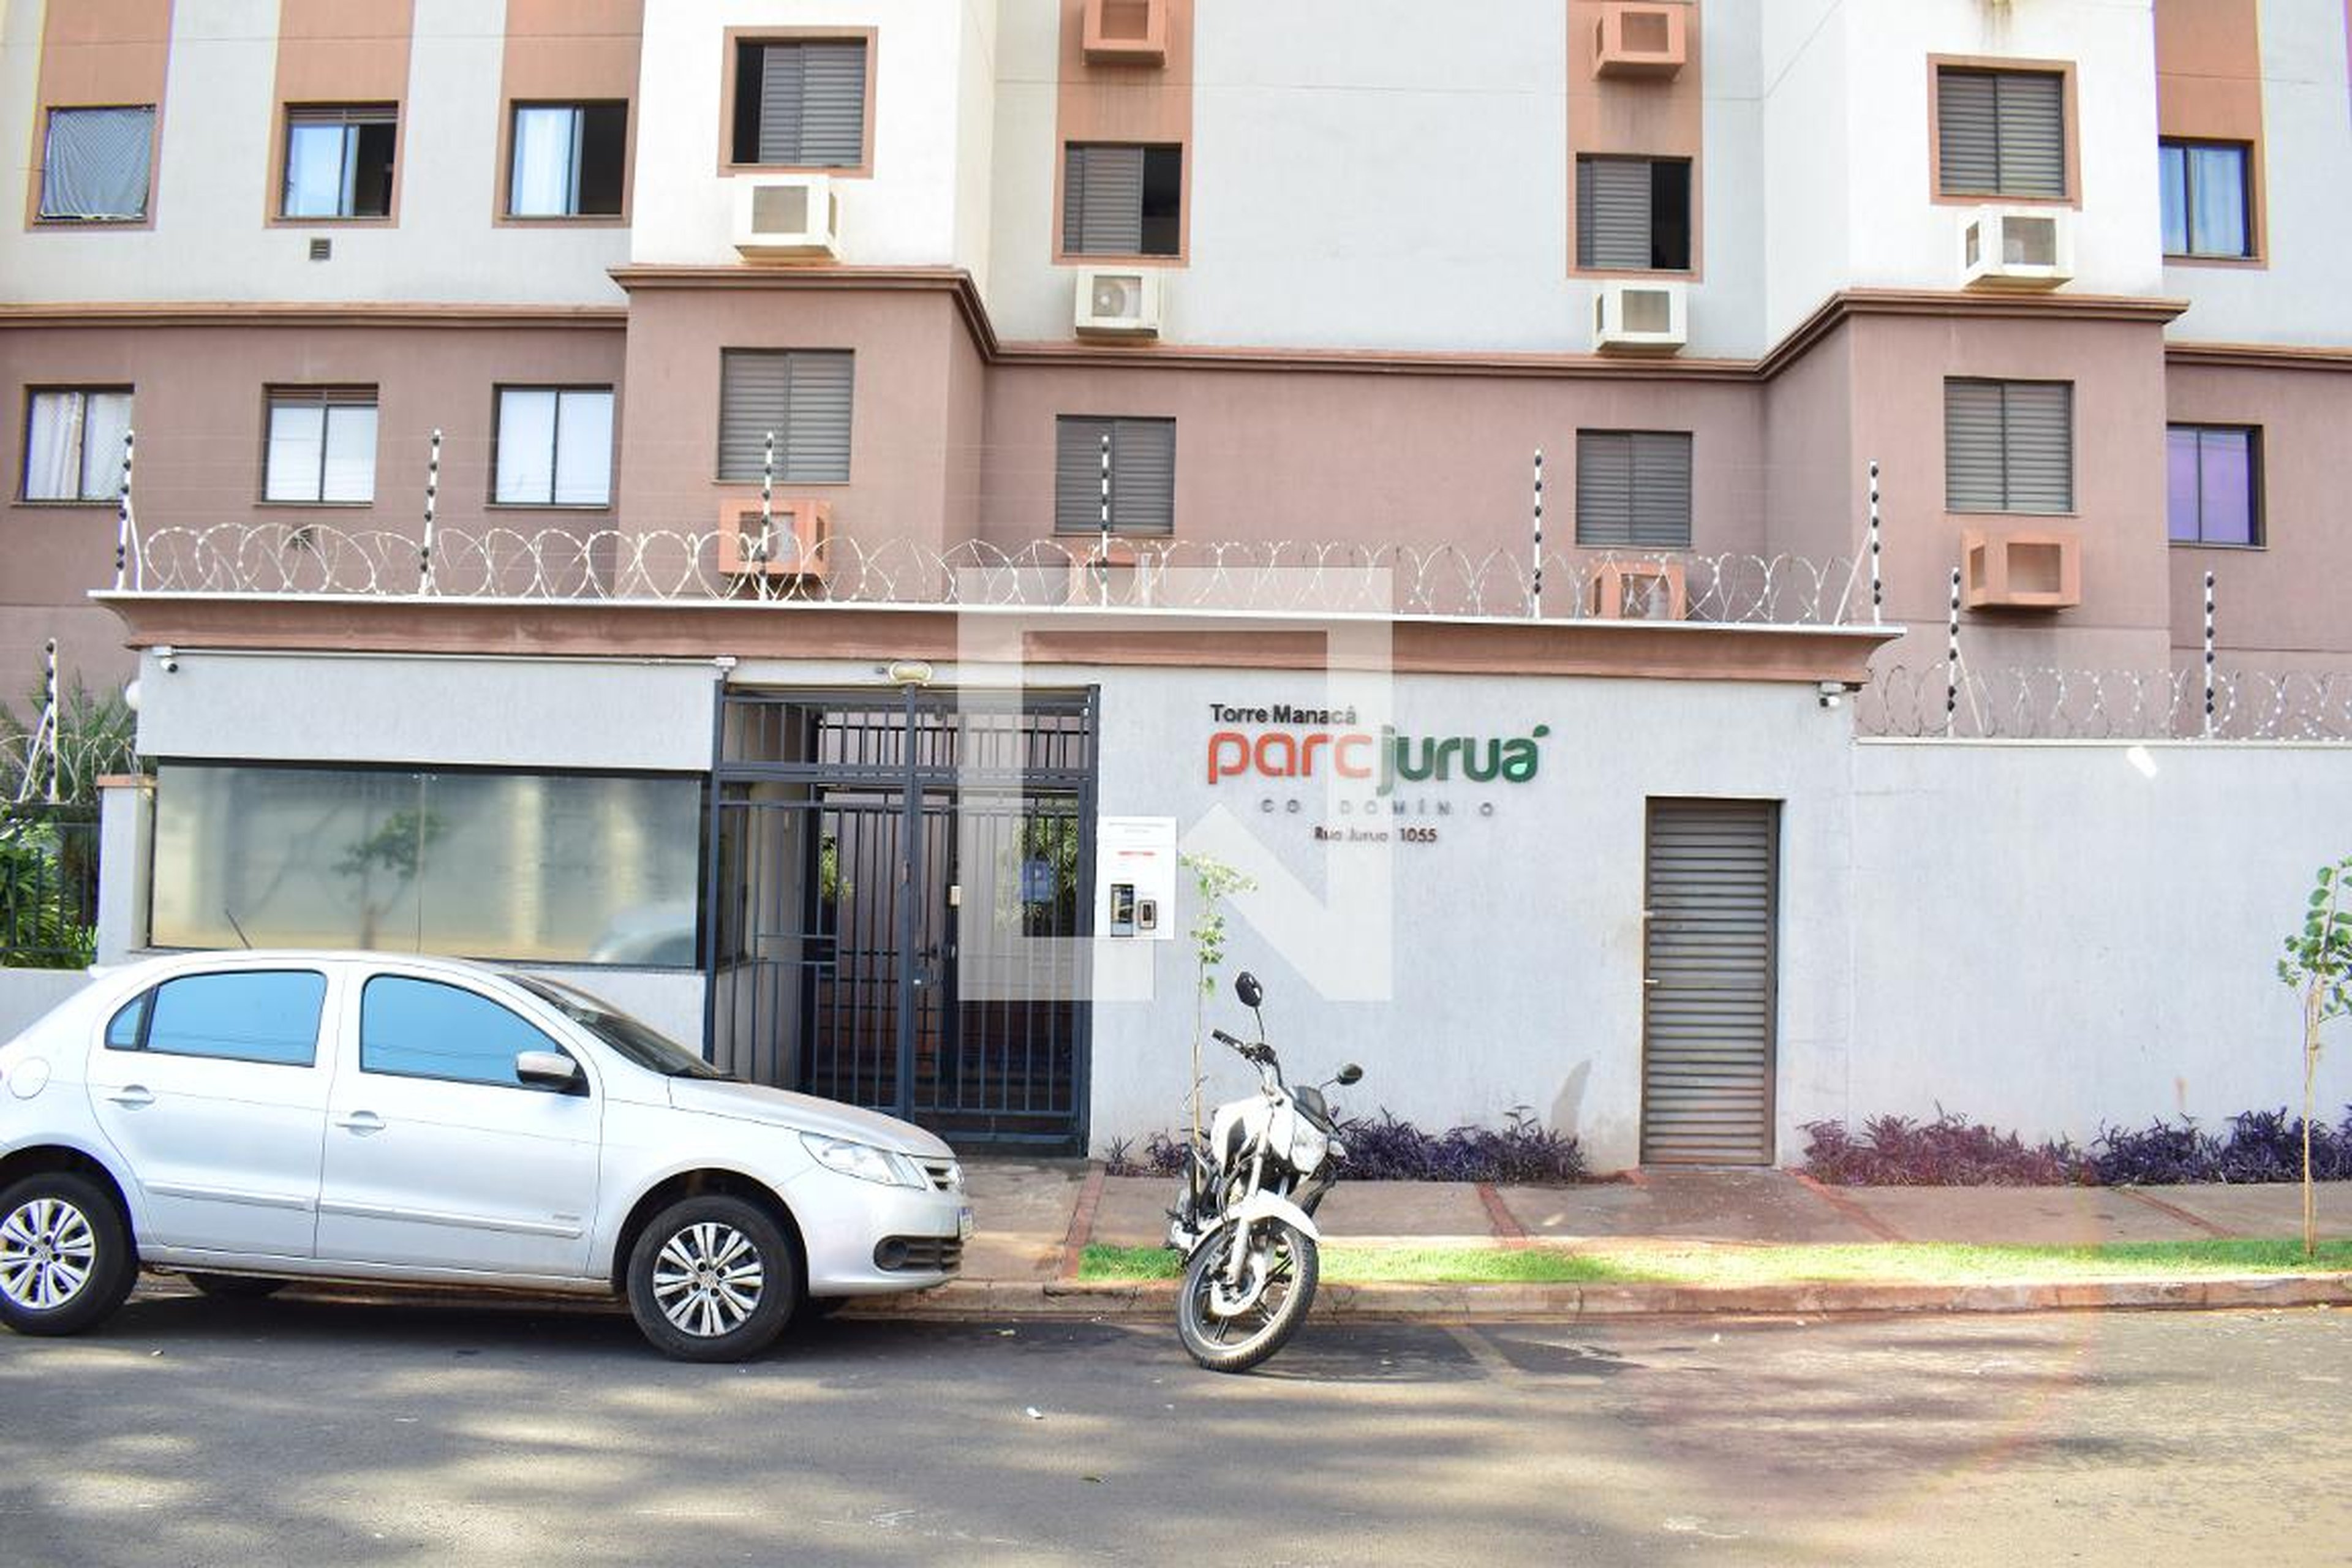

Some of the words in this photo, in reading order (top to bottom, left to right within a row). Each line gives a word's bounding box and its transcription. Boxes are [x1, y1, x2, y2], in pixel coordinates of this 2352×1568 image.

[1210, 704, 1268, 723] Torre
[1273, 705, 1357, 725] Manacá
[1400, 827, 1438, 843] 1055
